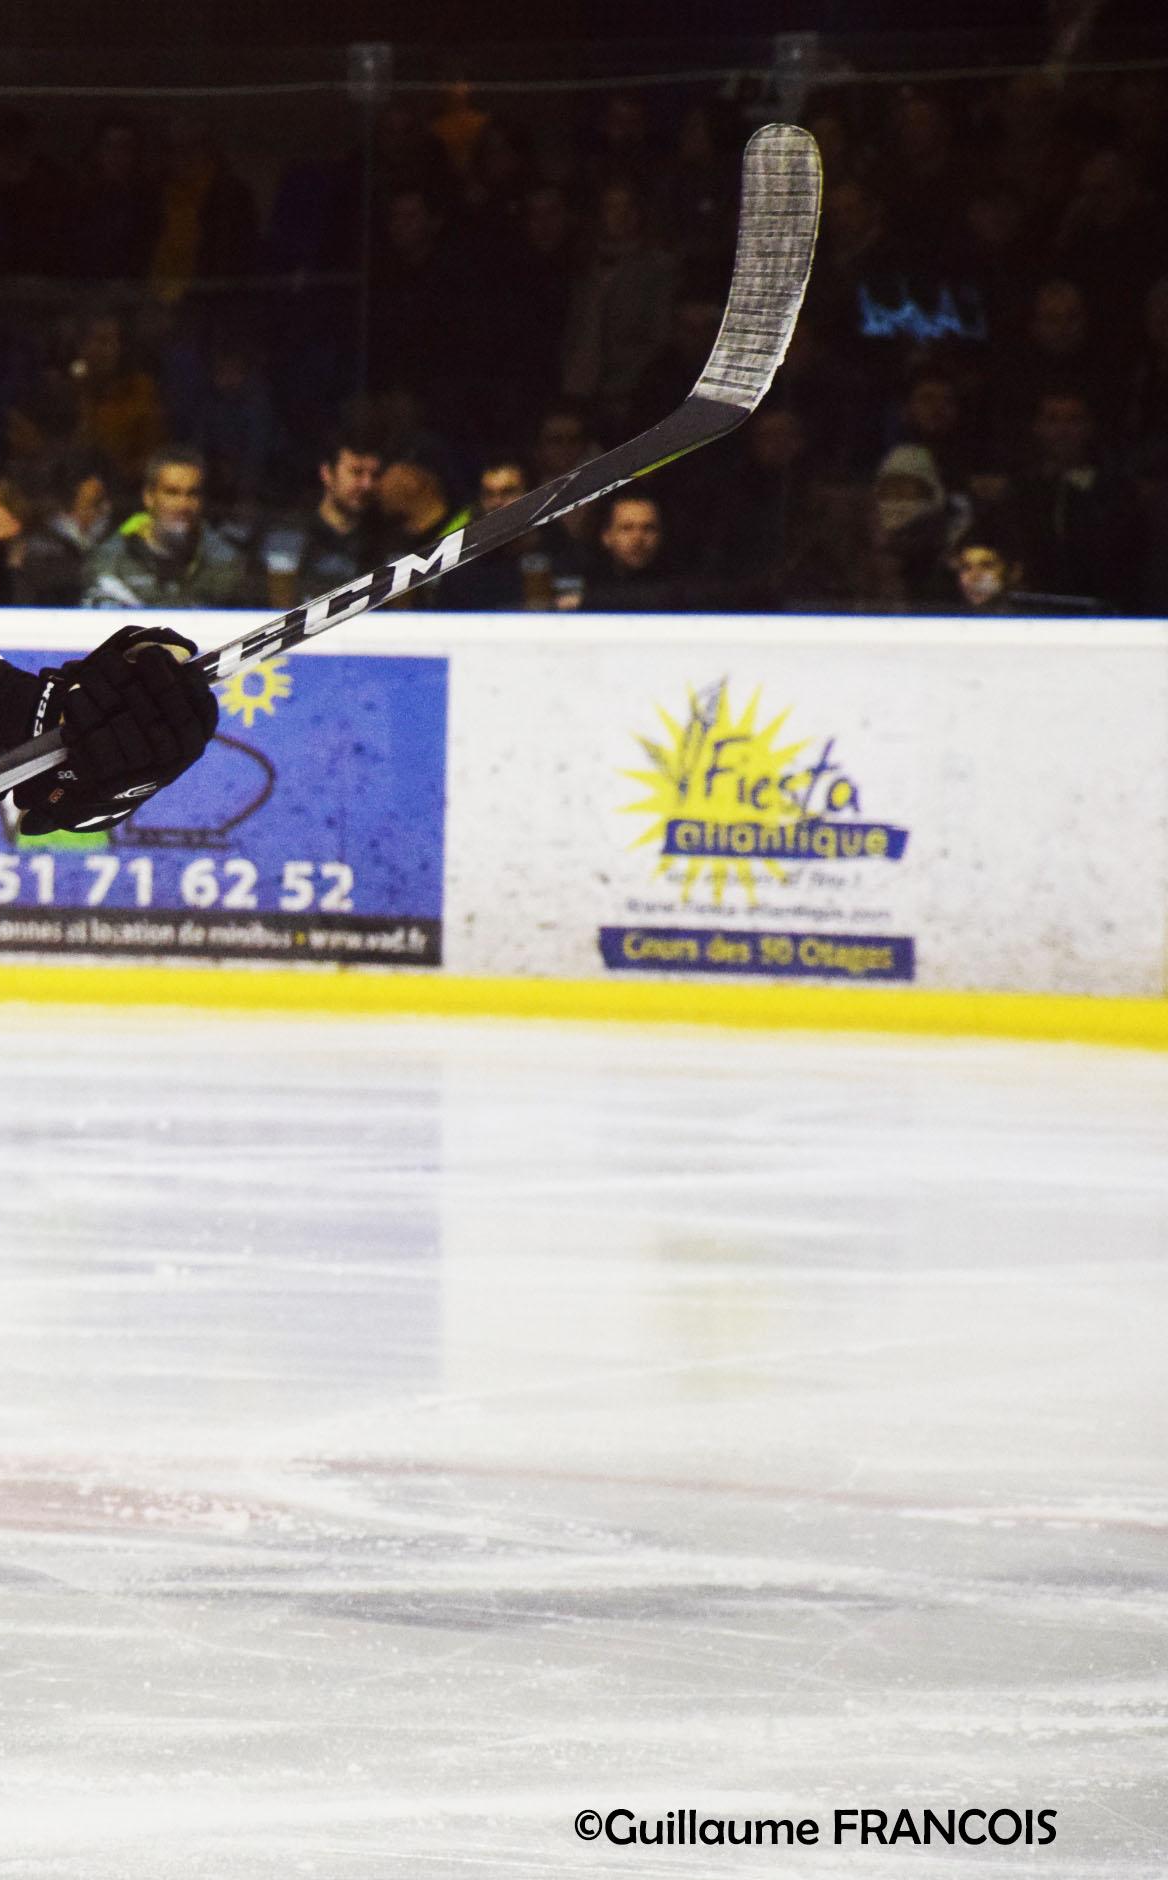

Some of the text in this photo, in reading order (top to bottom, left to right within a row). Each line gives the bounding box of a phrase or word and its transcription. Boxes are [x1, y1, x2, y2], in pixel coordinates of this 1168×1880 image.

[217, 528, 465, 678] CCM
[704, 736, 861, 818] Fiesta
[84, 856, 153, 906] 71
[180, 858, 258, 910] 62
[281, 862, 354, 913] 52
